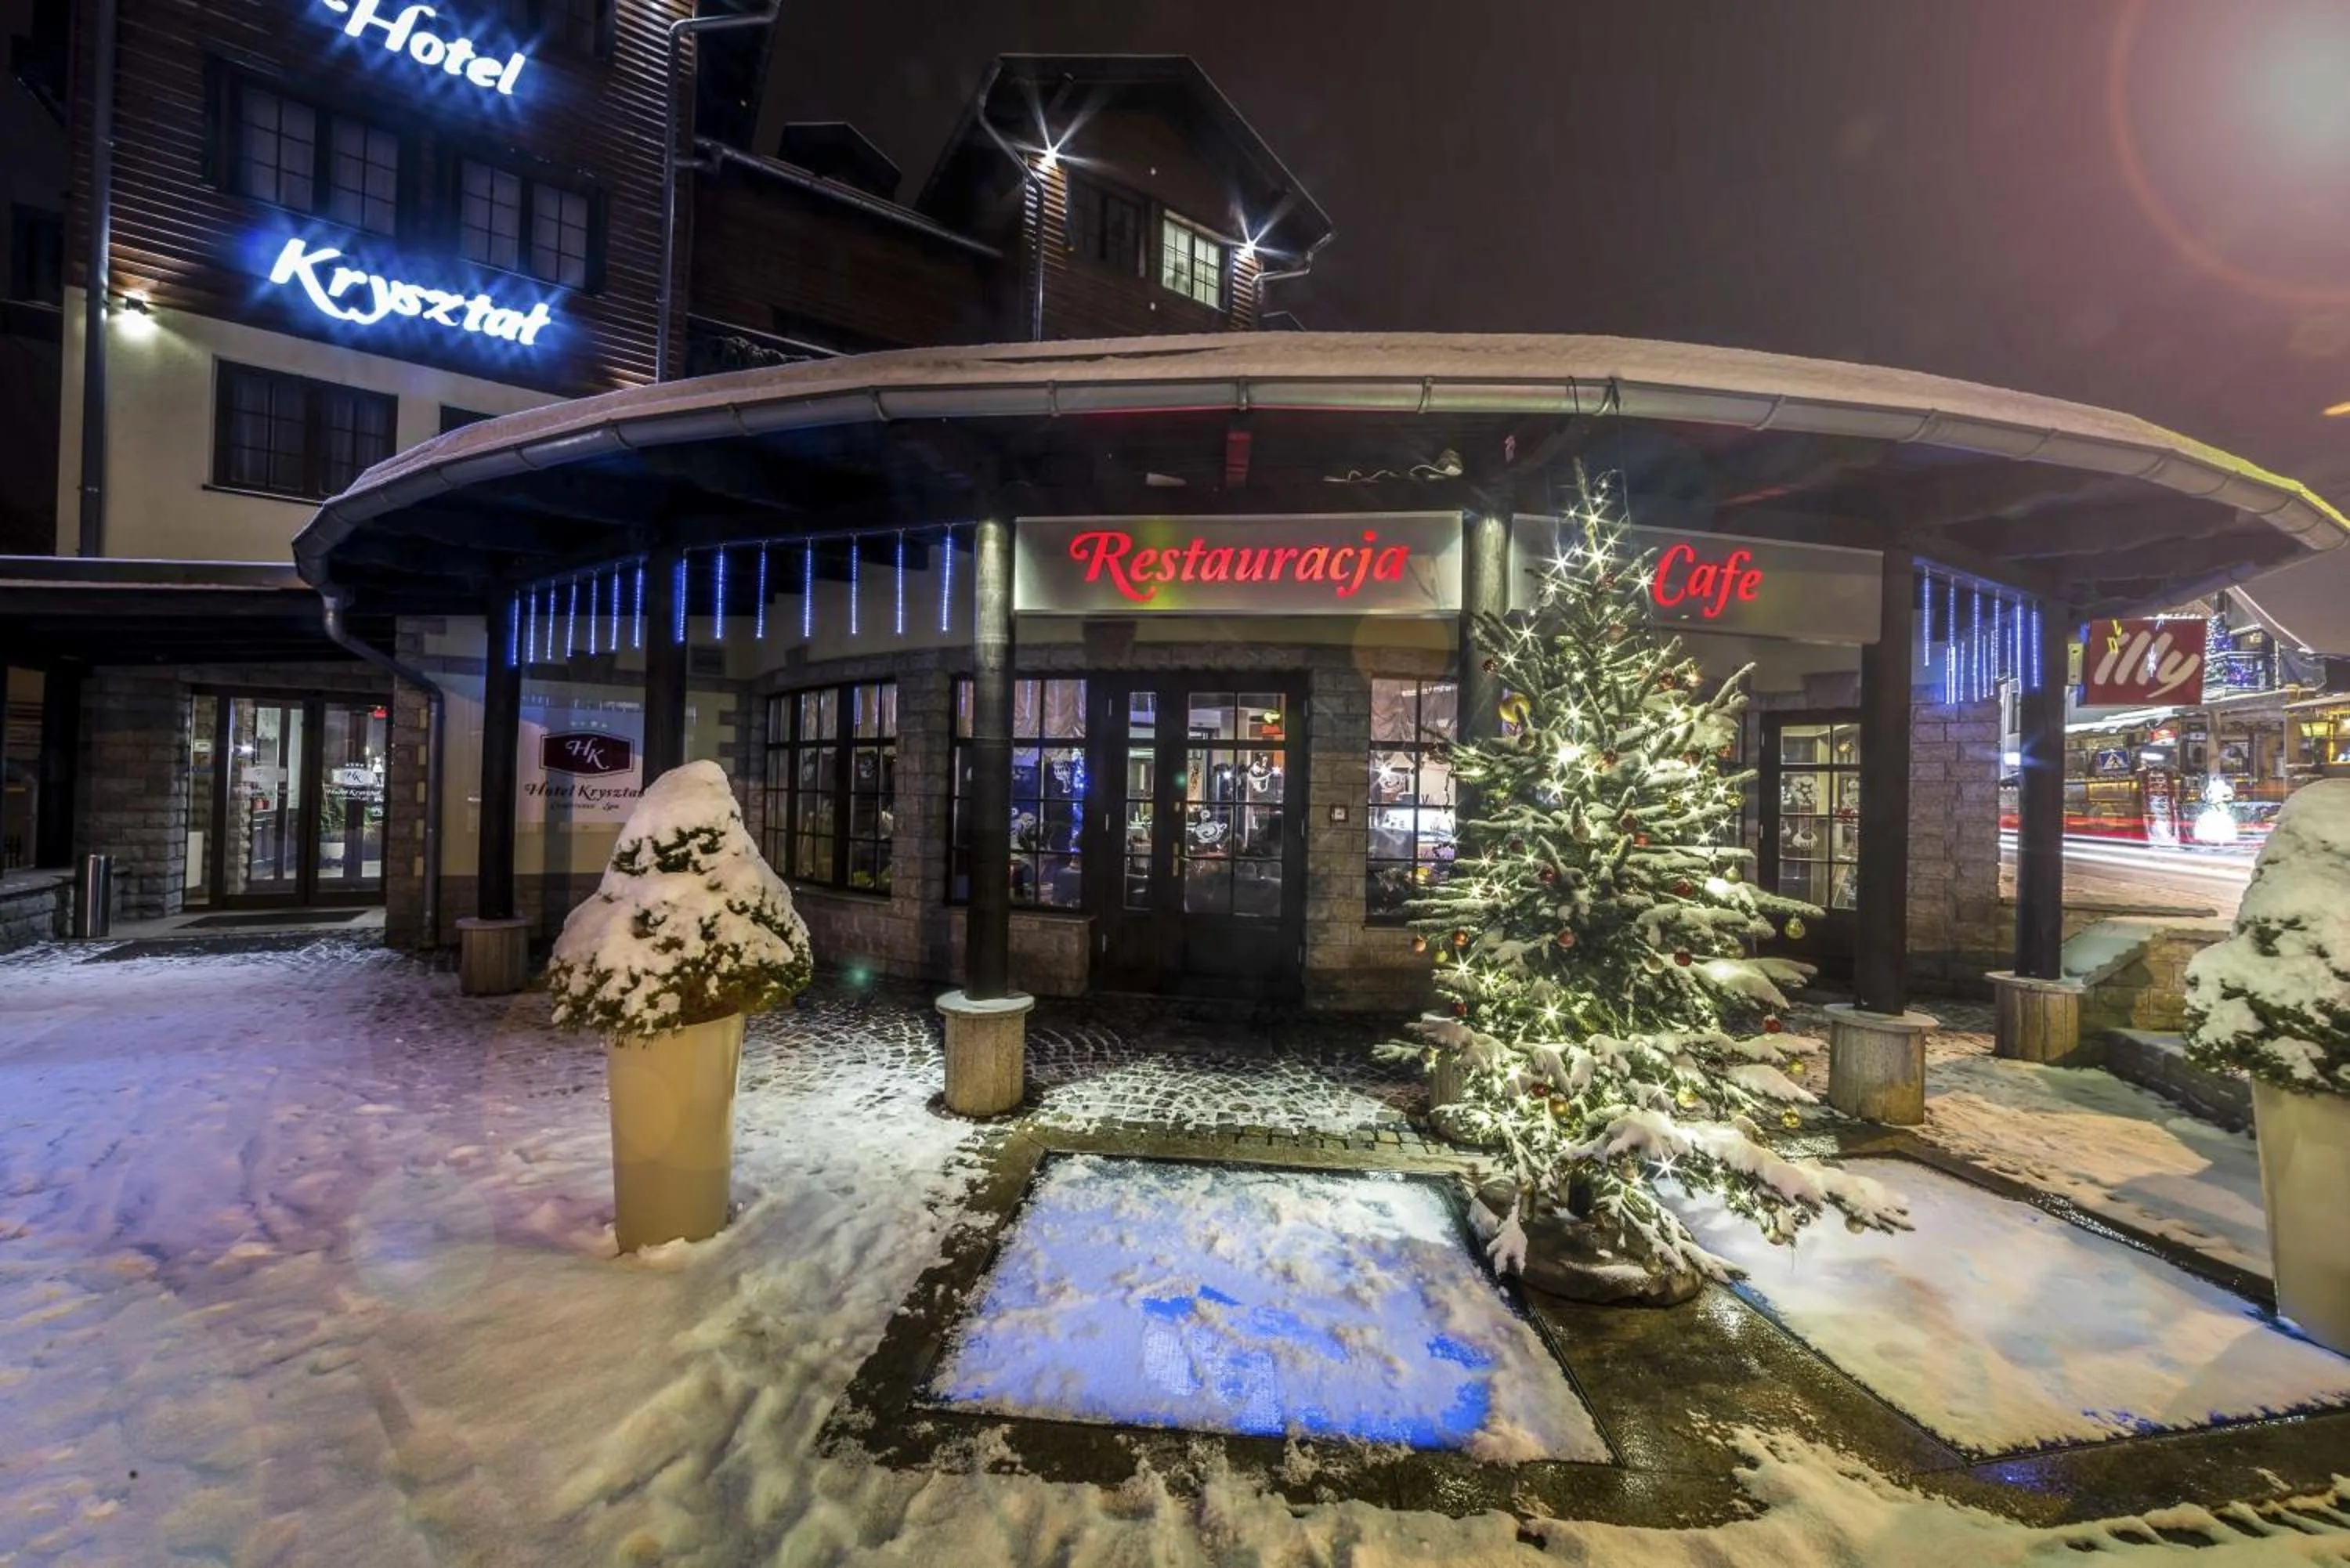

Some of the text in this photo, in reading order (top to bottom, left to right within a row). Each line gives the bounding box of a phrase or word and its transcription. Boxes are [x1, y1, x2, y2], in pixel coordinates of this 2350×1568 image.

[322, 0, 526, 95] Hotel
[1069, 530, 1409, 602] Restauracja
[1654, 543, 1764, 619] Cafe
[2093, 630, 2201, 699] illy
[524, 781, 575, 798] Hotel
